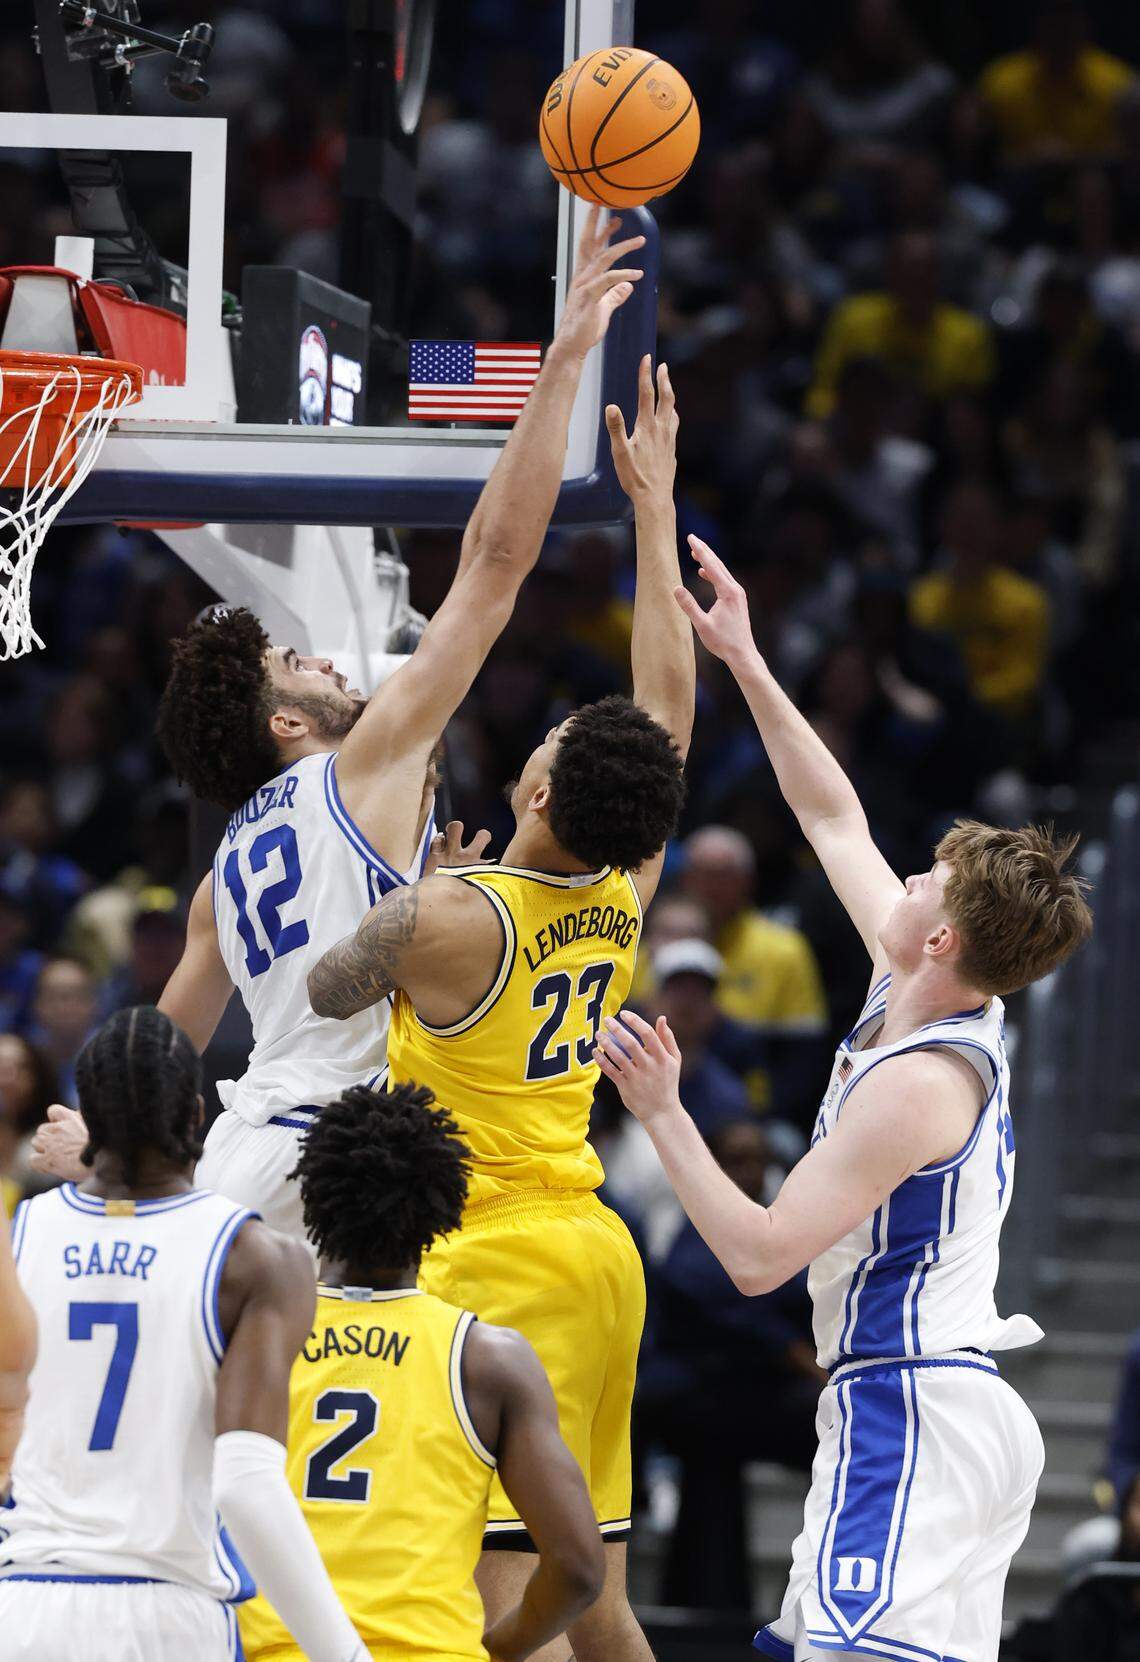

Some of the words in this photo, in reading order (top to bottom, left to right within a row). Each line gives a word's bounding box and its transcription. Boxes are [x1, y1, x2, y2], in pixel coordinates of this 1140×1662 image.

[223, 823, 310, 979] 12
[522, 905, 638, 973] LENDEBORG
[524, 960, 616, 1083] 23
[63, 1241, 157, 1281] SARR
[68, 1301, 140, 1452] 7
[303, 1387, 380, 1504] 2
[833, 1556, 878, 1593] D
